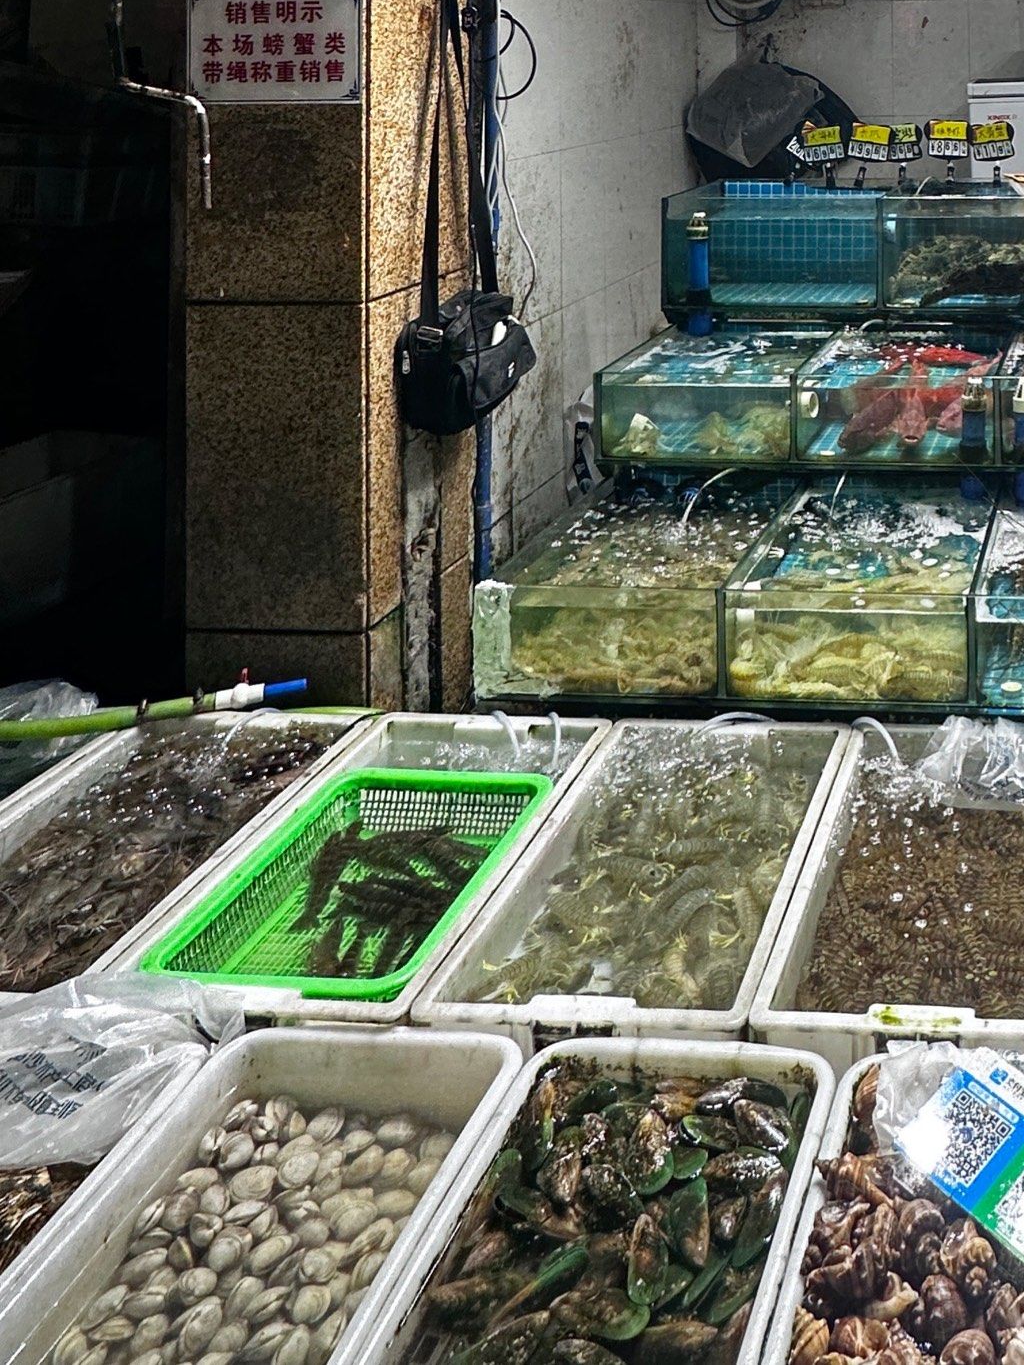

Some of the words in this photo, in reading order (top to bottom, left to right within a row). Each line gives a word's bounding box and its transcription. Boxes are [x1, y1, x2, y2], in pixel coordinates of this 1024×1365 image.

[225, 0, 323, 25] 销售明示
[202, 31, 346, 57] 本场螃蟹类
[202, 58, 346, 84] 带绳称重销售
